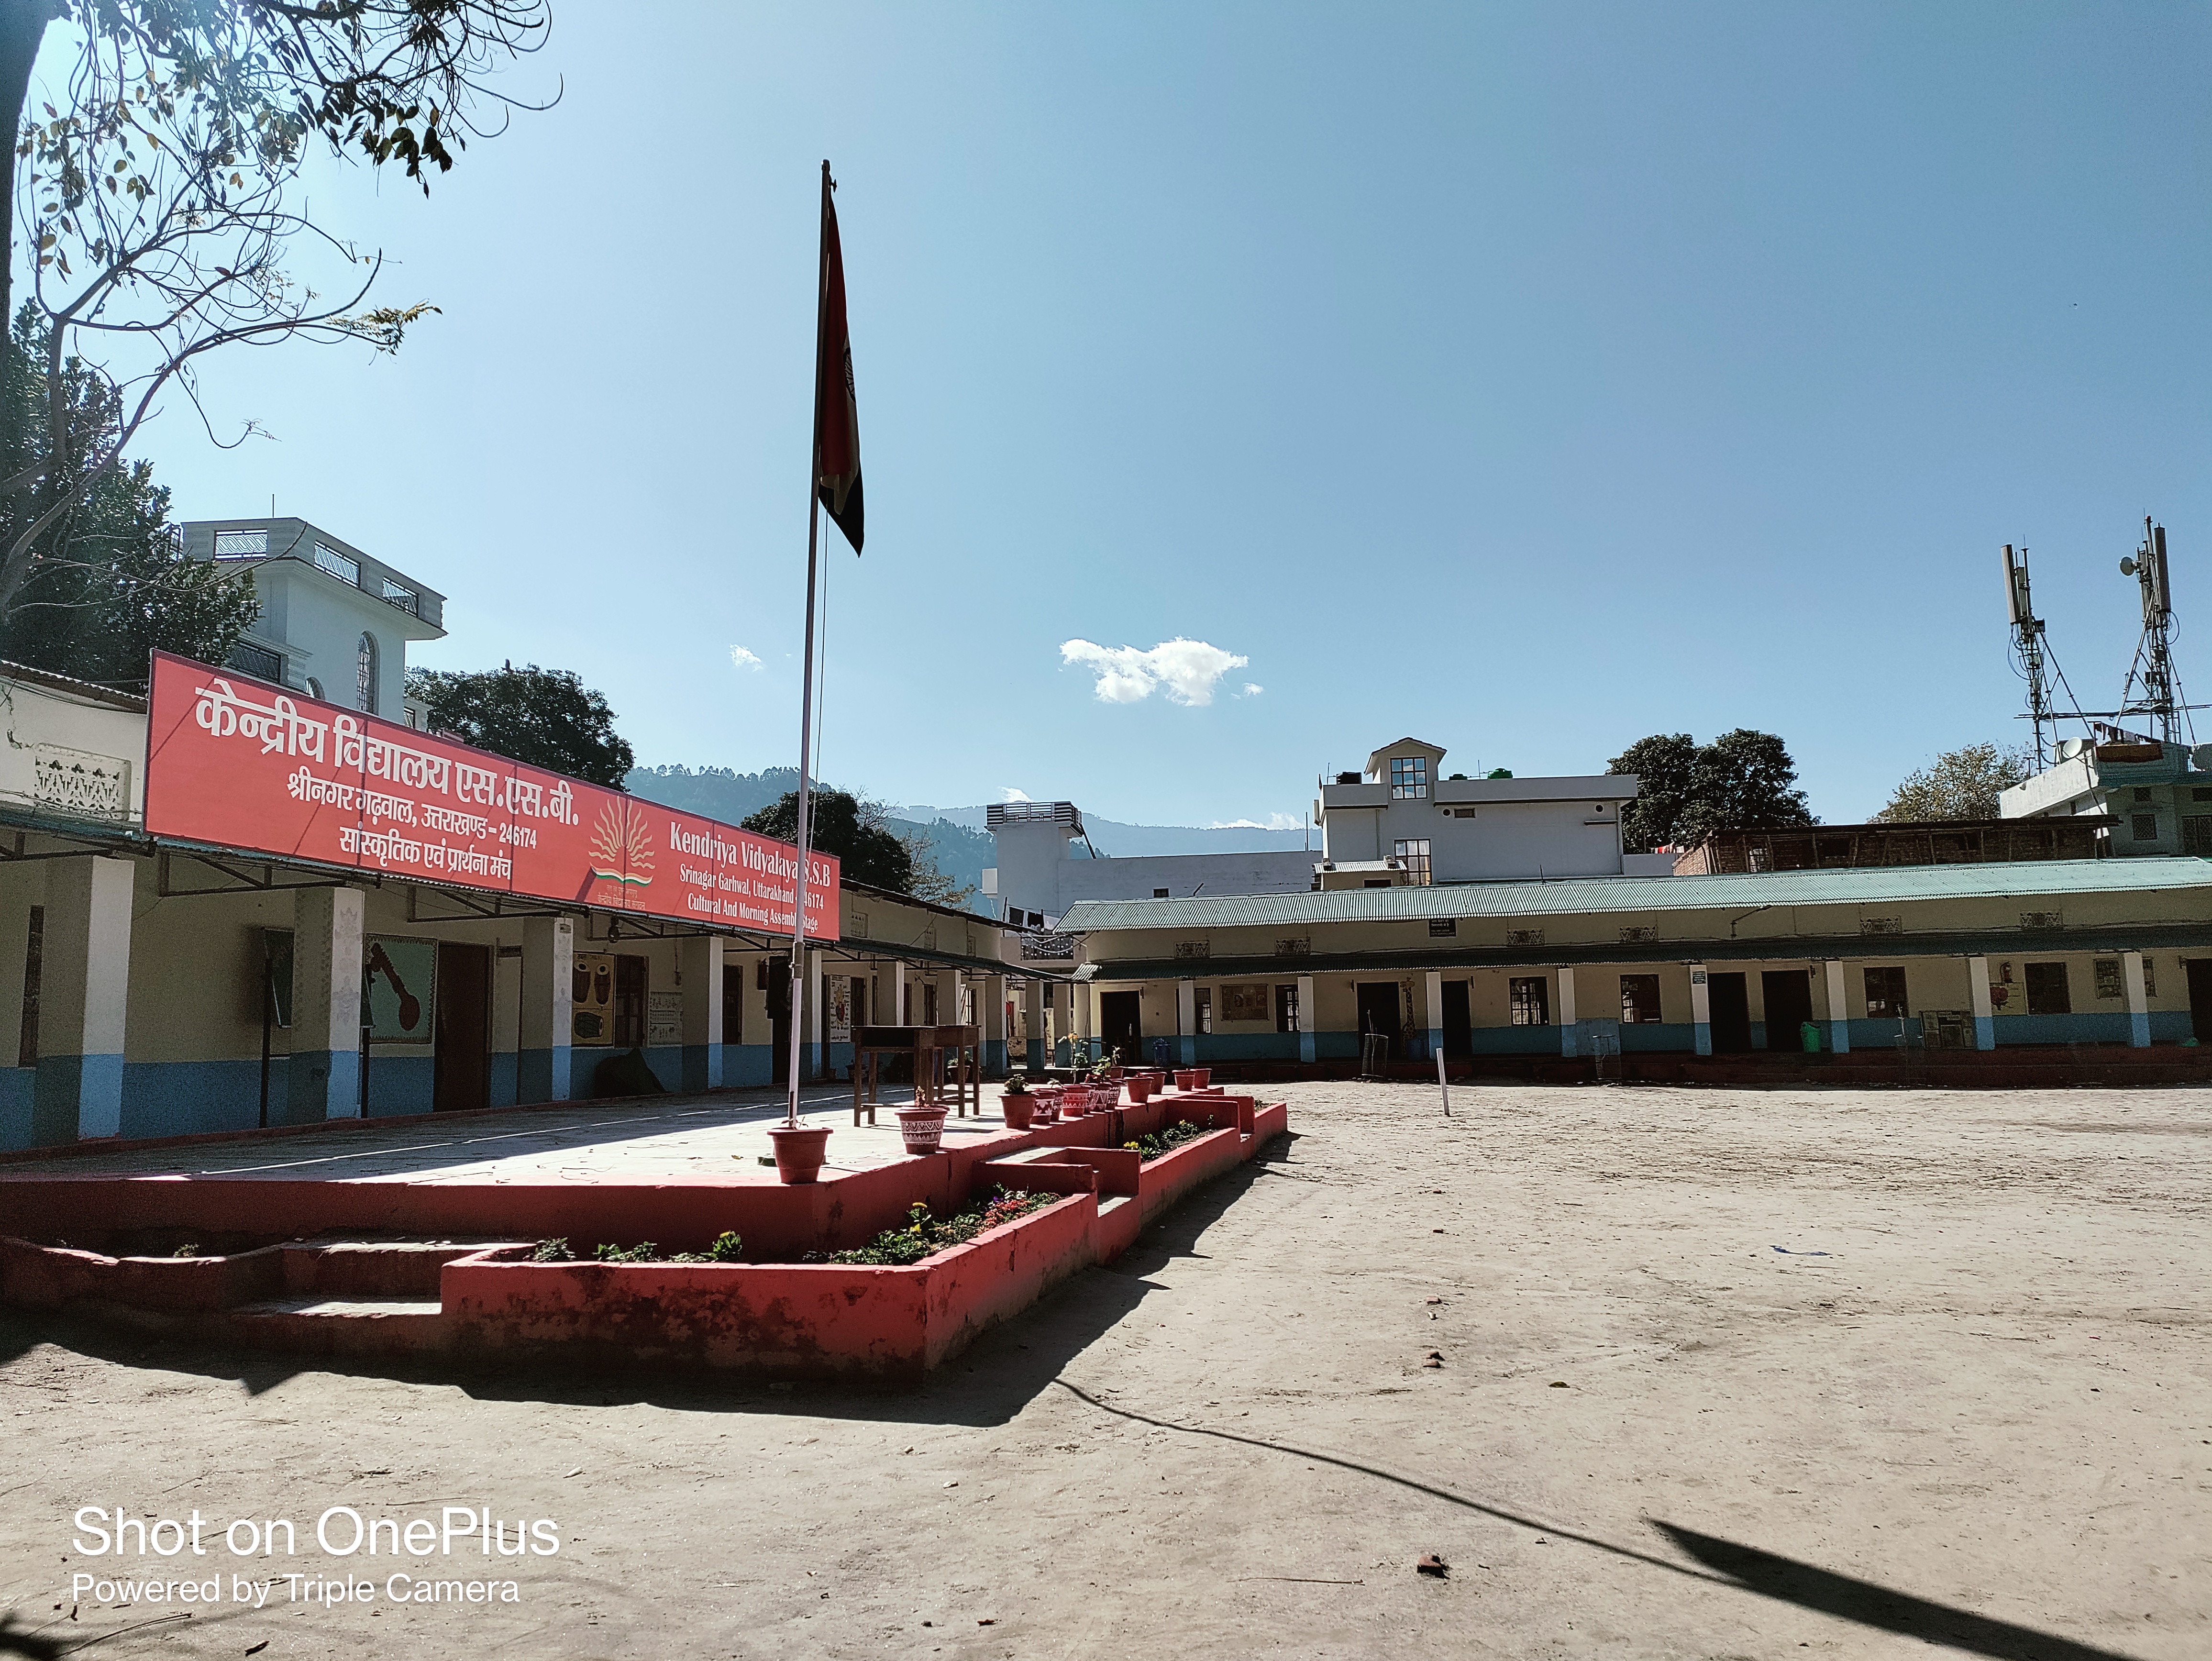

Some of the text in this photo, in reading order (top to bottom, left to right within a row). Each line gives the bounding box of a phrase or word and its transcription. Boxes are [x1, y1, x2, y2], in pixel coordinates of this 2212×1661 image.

[195, 678, 579, 826] केन्द्रीय विद्यालय एस.एस.बी.
[287, 765, 354, 811] श्रीनगर
[355, 787, 417, 828] गढ़वाल,
[421, 803, 488, 840] उत्तराखण्ड
[499, 822, 537, 849] 246174
[339, 820, 512, 880] सांस्कृतिक एवं प्रार्थना मंच
[670, 821, 737, 868] Kendriya
[741, 841, 798, 883] Vidyalaya
[680, 863, 716, 890] Srinagar
[719, 872, 751, 897] Garhwal,
[753, 880, 794, 904] Uttarakhand
[688, 893, 721, 915] Cultural
[722, 899, 737, 917] And
[739, 902, 768, 926] Morning
[770, 908, 796, 927] Assembl
